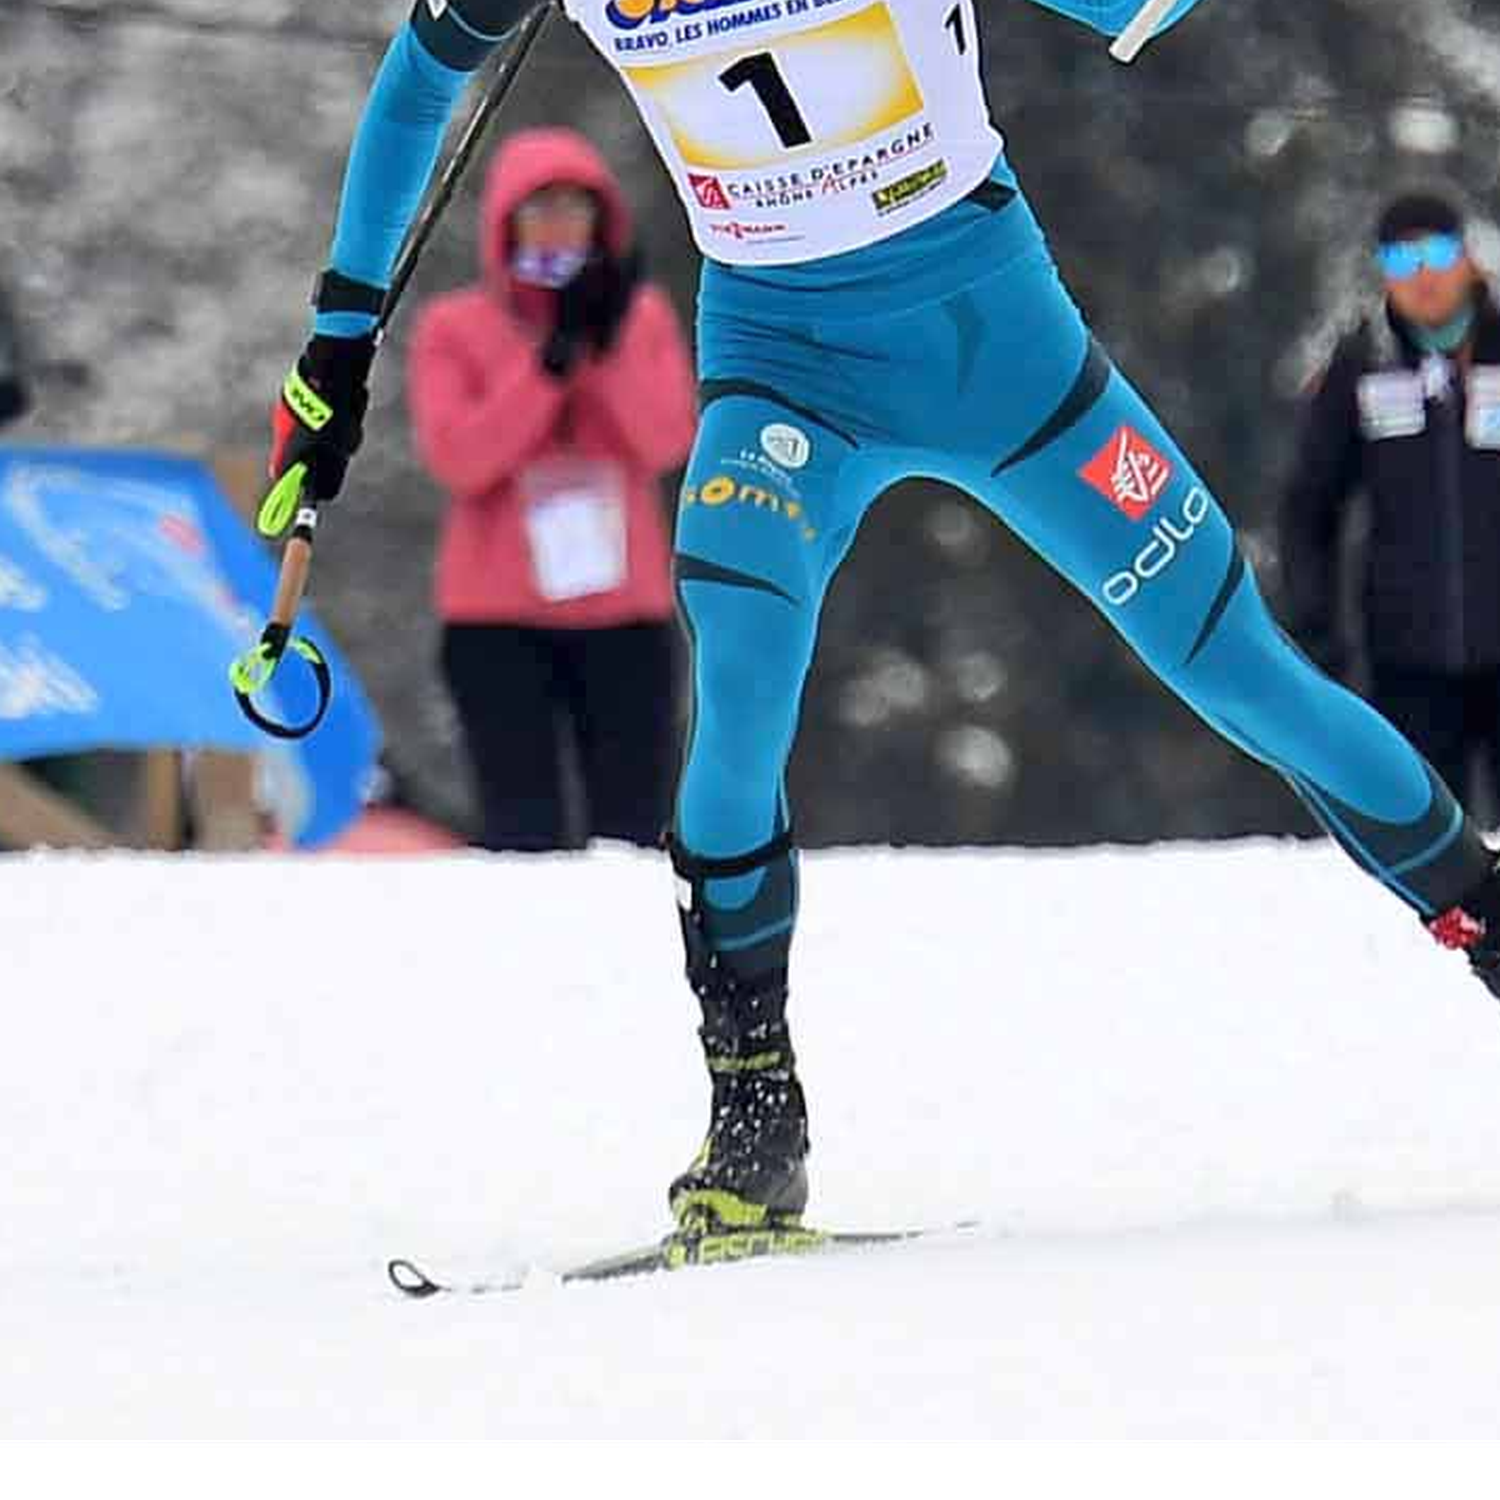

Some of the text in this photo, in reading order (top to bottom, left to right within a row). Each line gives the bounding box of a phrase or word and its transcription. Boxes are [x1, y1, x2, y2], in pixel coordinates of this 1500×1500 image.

[675, 22, 702, 44] LES
[706, 1, 783, 36] HOMMES
[945, 3, 966, 56] 1
[718, 51, 812, 149] 1
[727, 172, 802, 197] CAISSE
[1102, 486, 1208, 606] odlo
